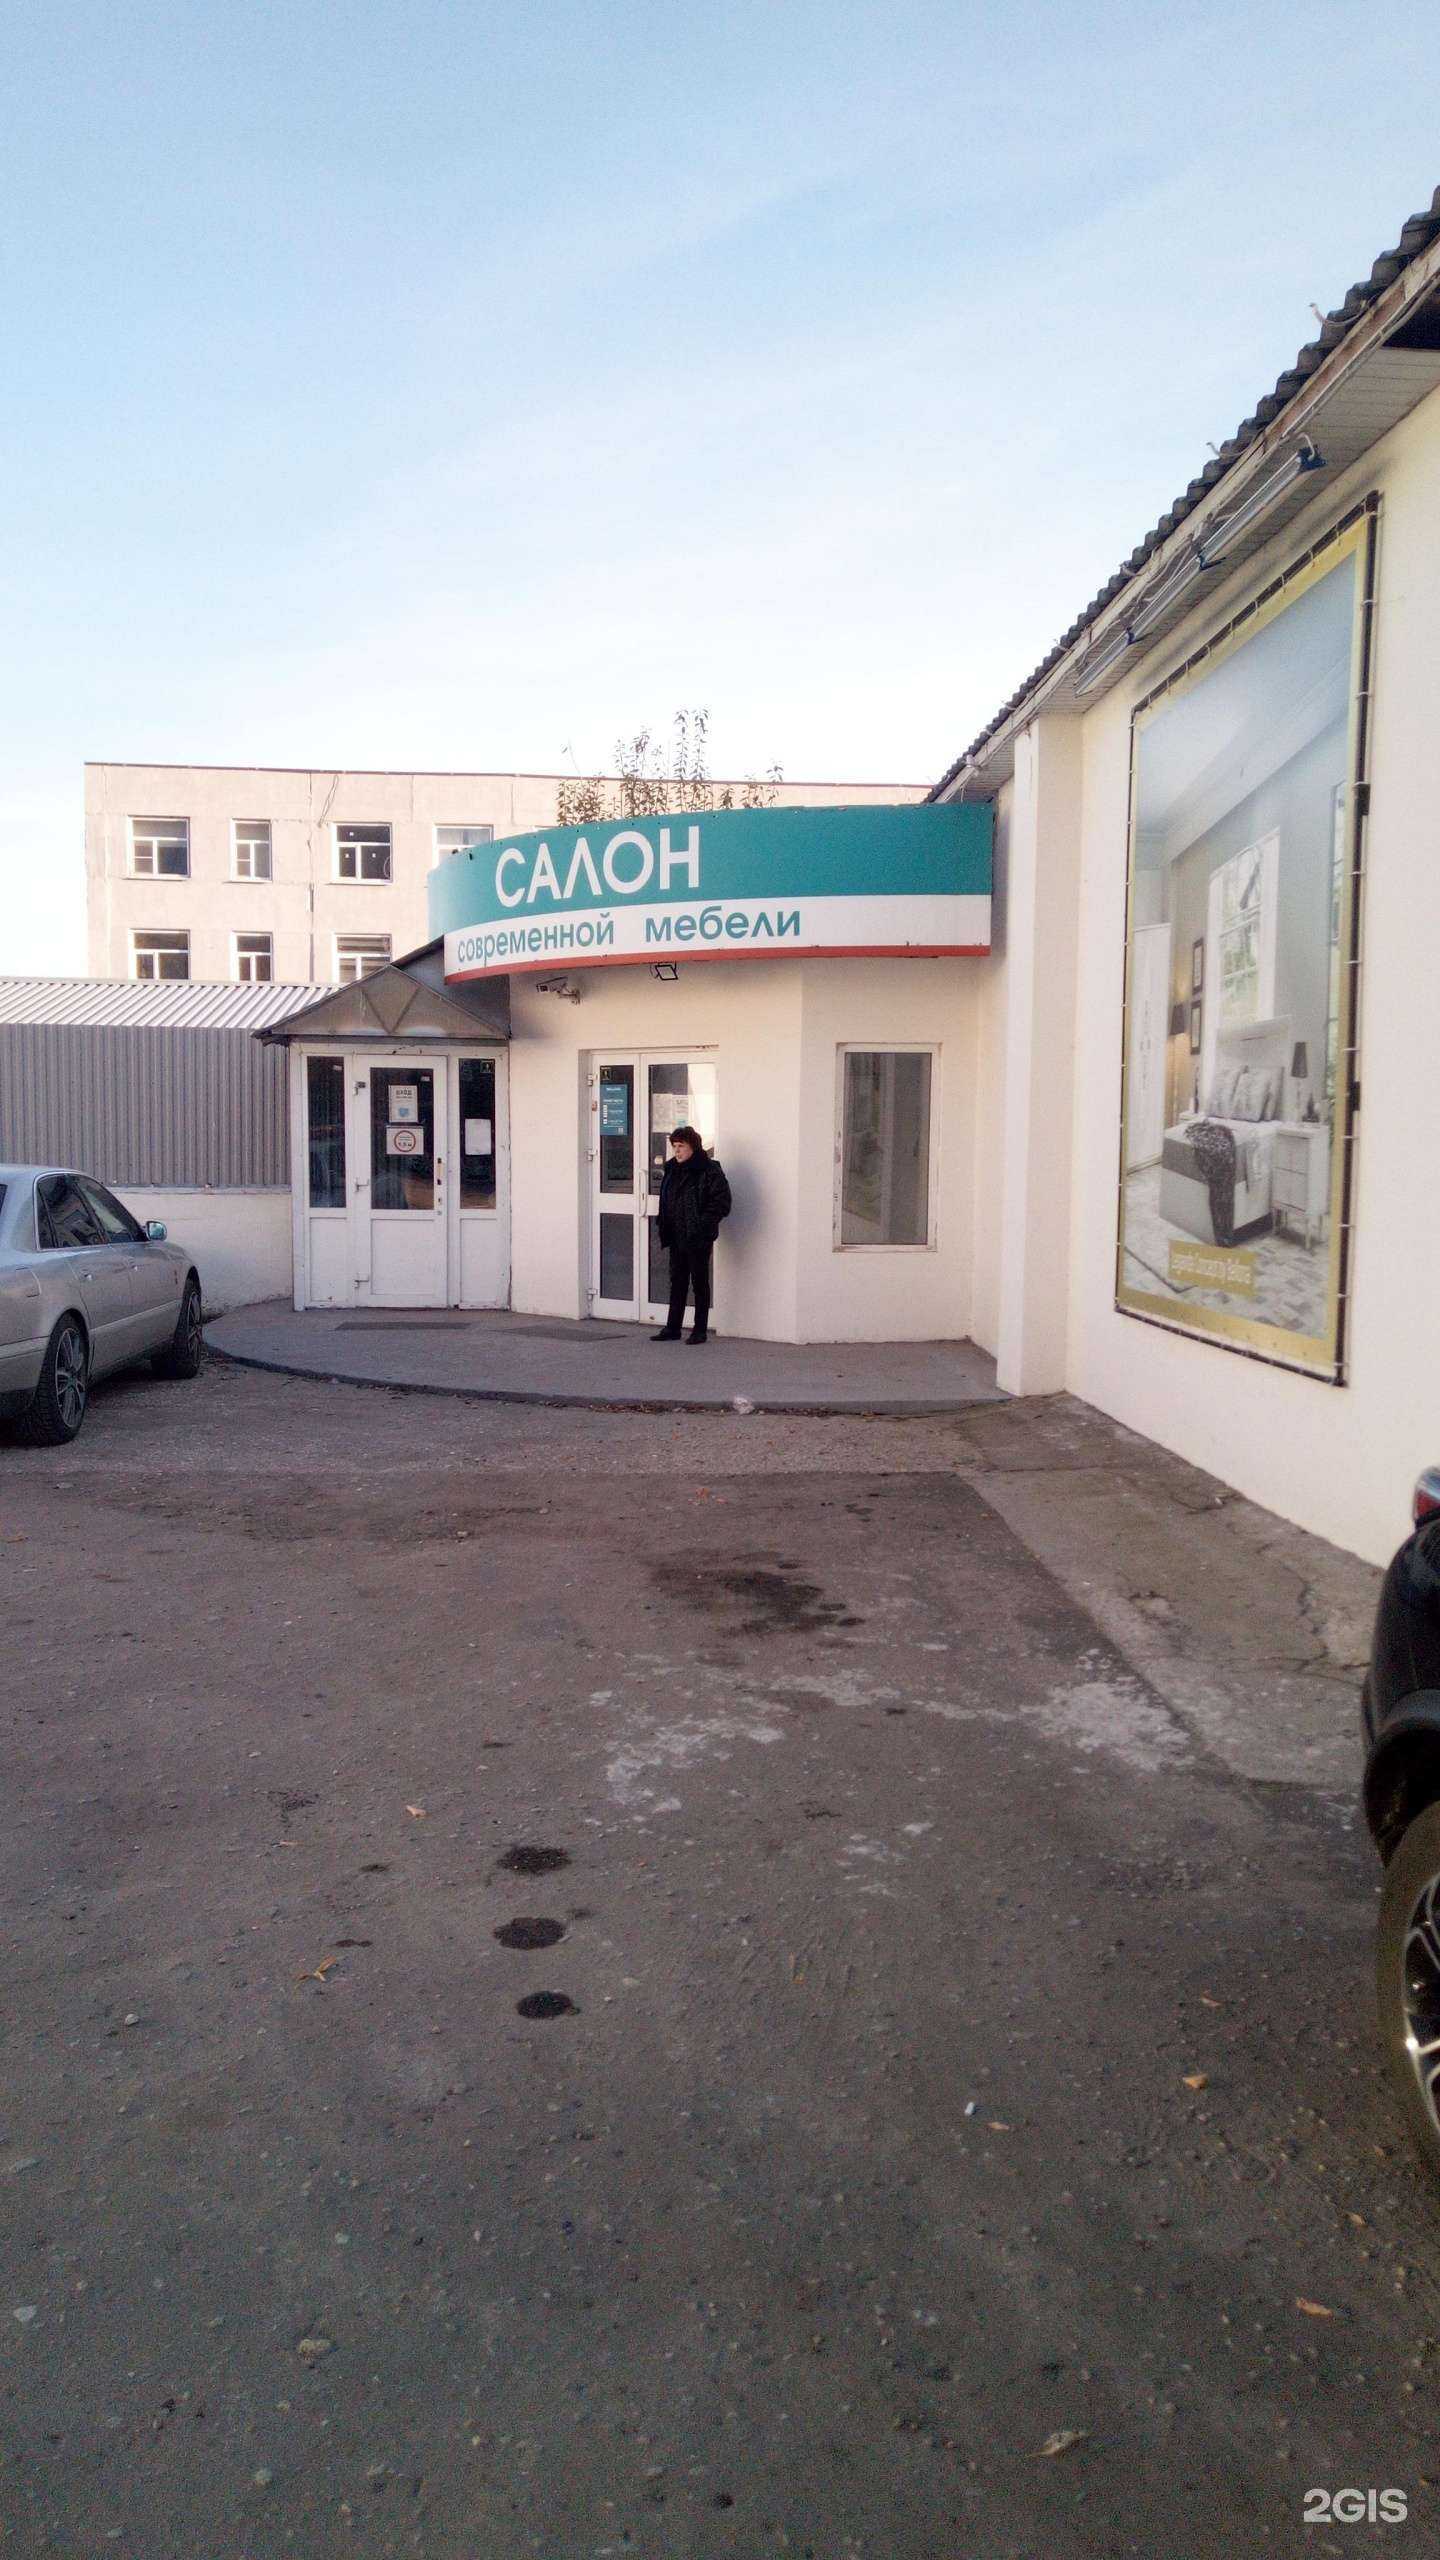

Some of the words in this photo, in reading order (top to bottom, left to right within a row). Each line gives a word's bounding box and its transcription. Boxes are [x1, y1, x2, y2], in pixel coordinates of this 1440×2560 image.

[495, 826, 700, 908] САЛОН
[457, 912, 614, 967] современной
[645, 905, 800, 943] мебели
